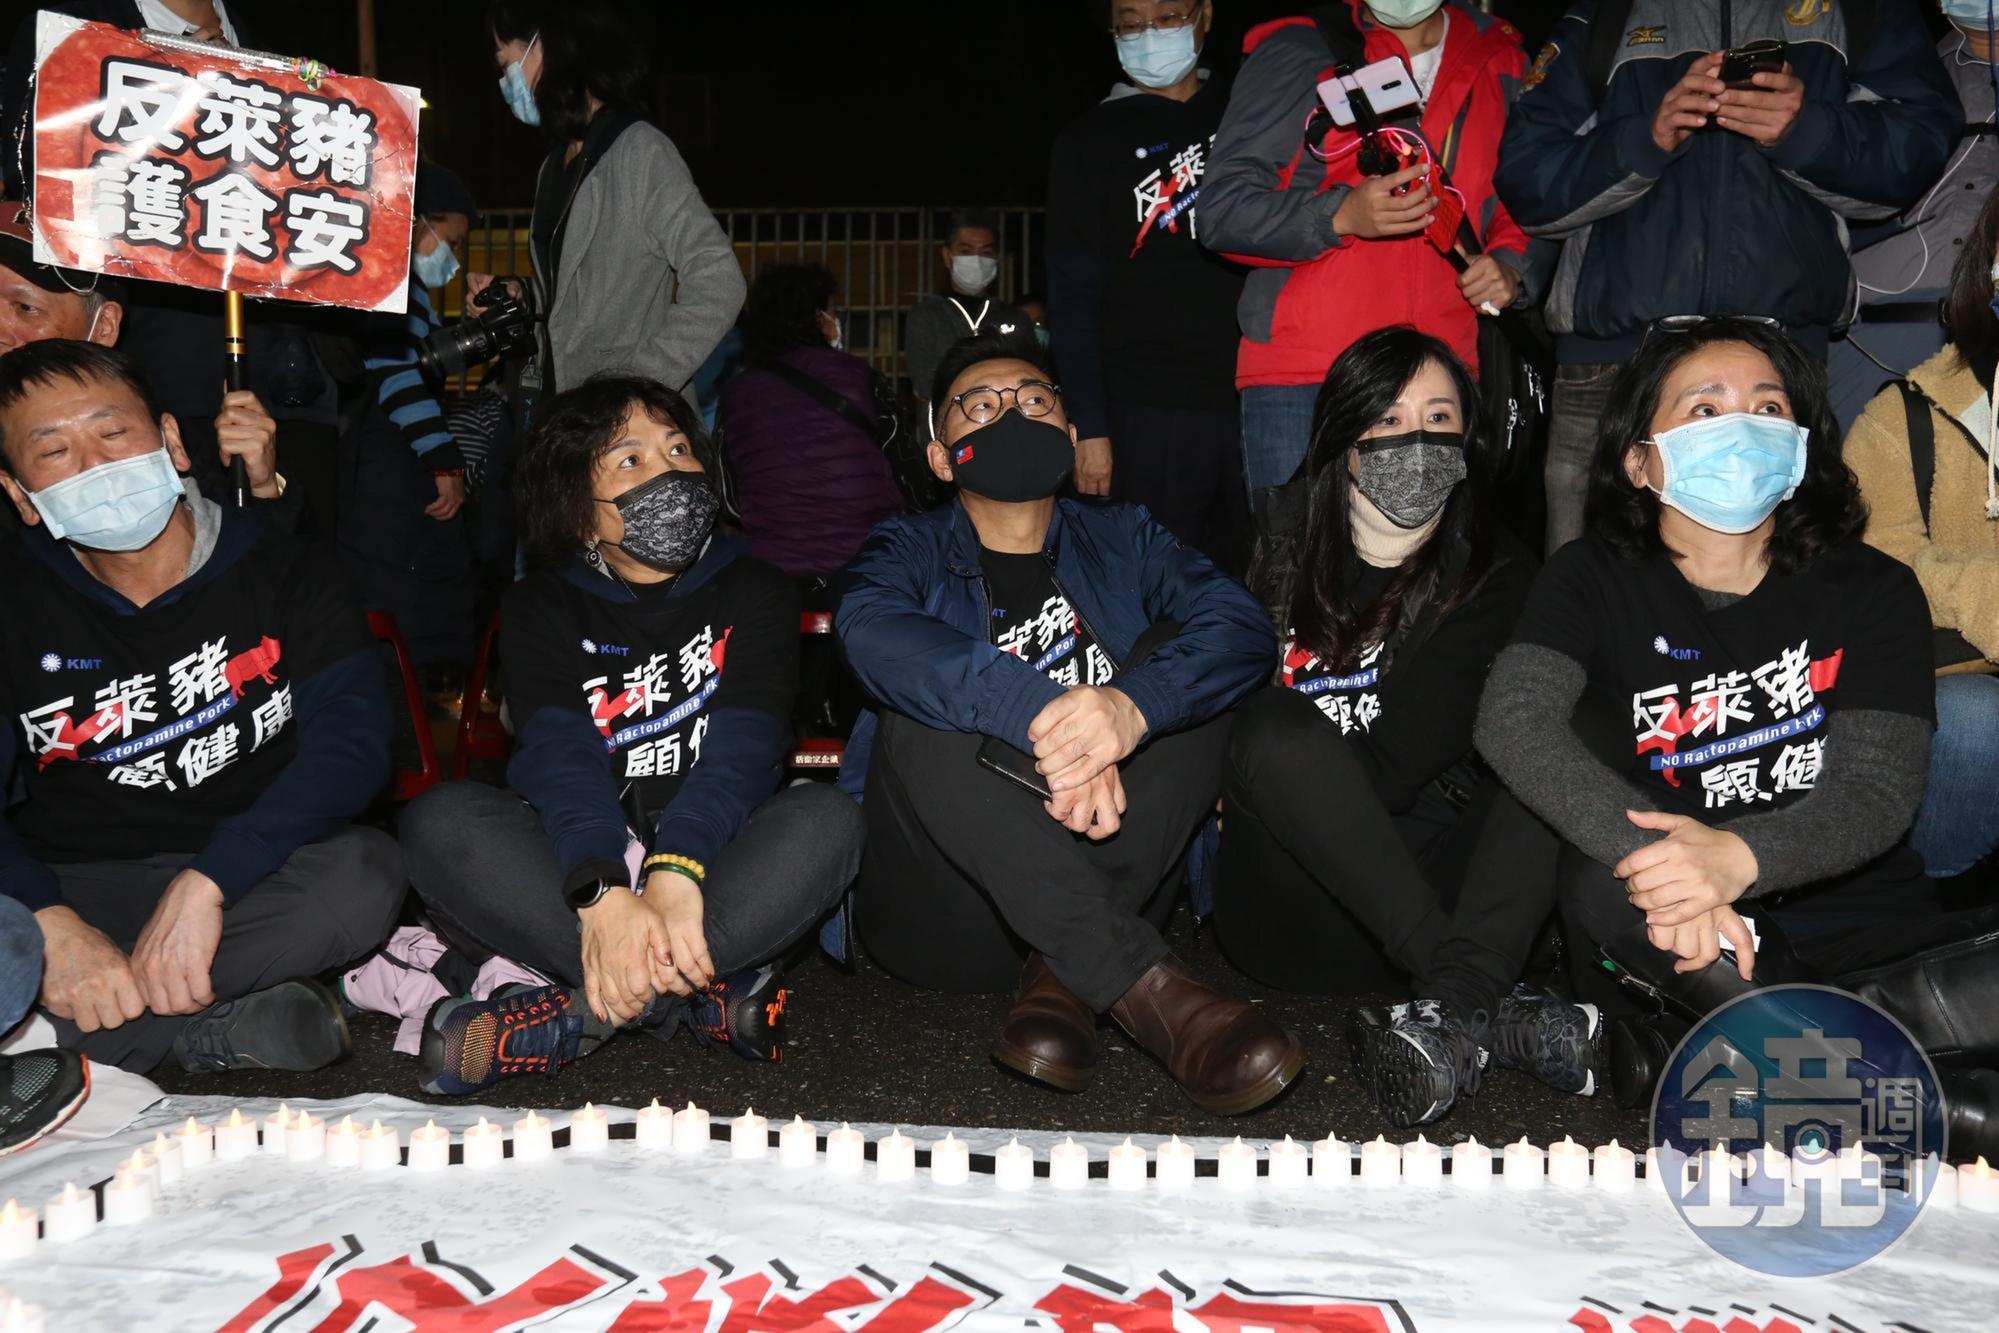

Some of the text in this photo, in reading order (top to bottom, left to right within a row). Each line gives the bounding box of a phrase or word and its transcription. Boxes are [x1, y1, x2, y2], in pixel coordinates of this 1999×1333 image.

[97, 60, 368, 186] 反萊豬
[97, 155, 365, 271] 護食安
[67, 658, 102, 670] KMT
[600, 643, 630, 657] KMT
[1669, 648, 1701, 660] KMT
[19, 635, 231, 756] 反萊豬
[198, 696, 232, 725] Pork
[1632, 638, 1815, 744] 反萊豬
[615, 696, 701, 744] Ractopamine
[1660, 755, 1680, 768] NO
[1684, 725, 1790, 765] Ractopamine
